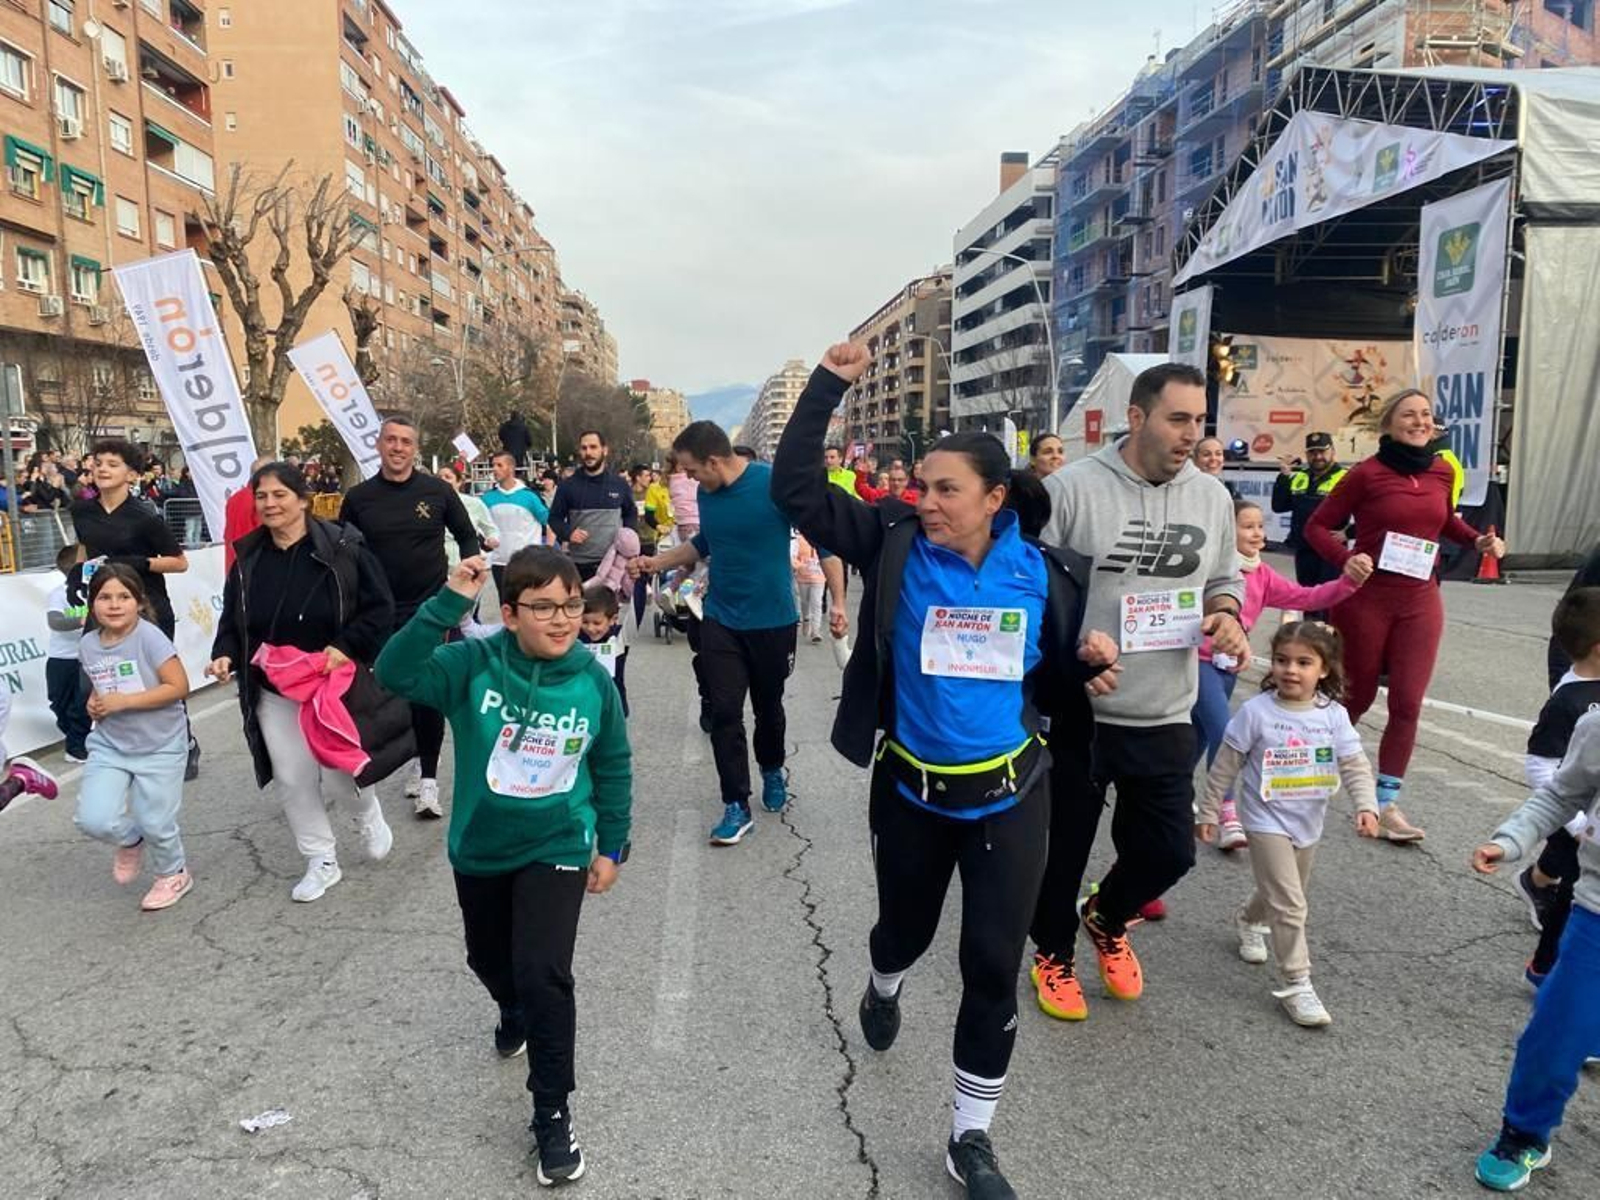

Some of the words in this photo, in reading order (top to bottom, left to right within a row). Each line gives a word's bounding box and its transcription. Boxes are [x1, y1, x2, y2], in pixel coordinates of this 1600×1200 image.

[1435, 372, 1485, 420] SAN
[947, 612, 979, 621] NOCHE
[980, 613, 993, 622] DE
[1149, 613, 1167, 627] 25
[935, 620, 955, 628] SAN
[956, 633, 987, 644] HUGO
[522, 756, 551, 769] HUGO
